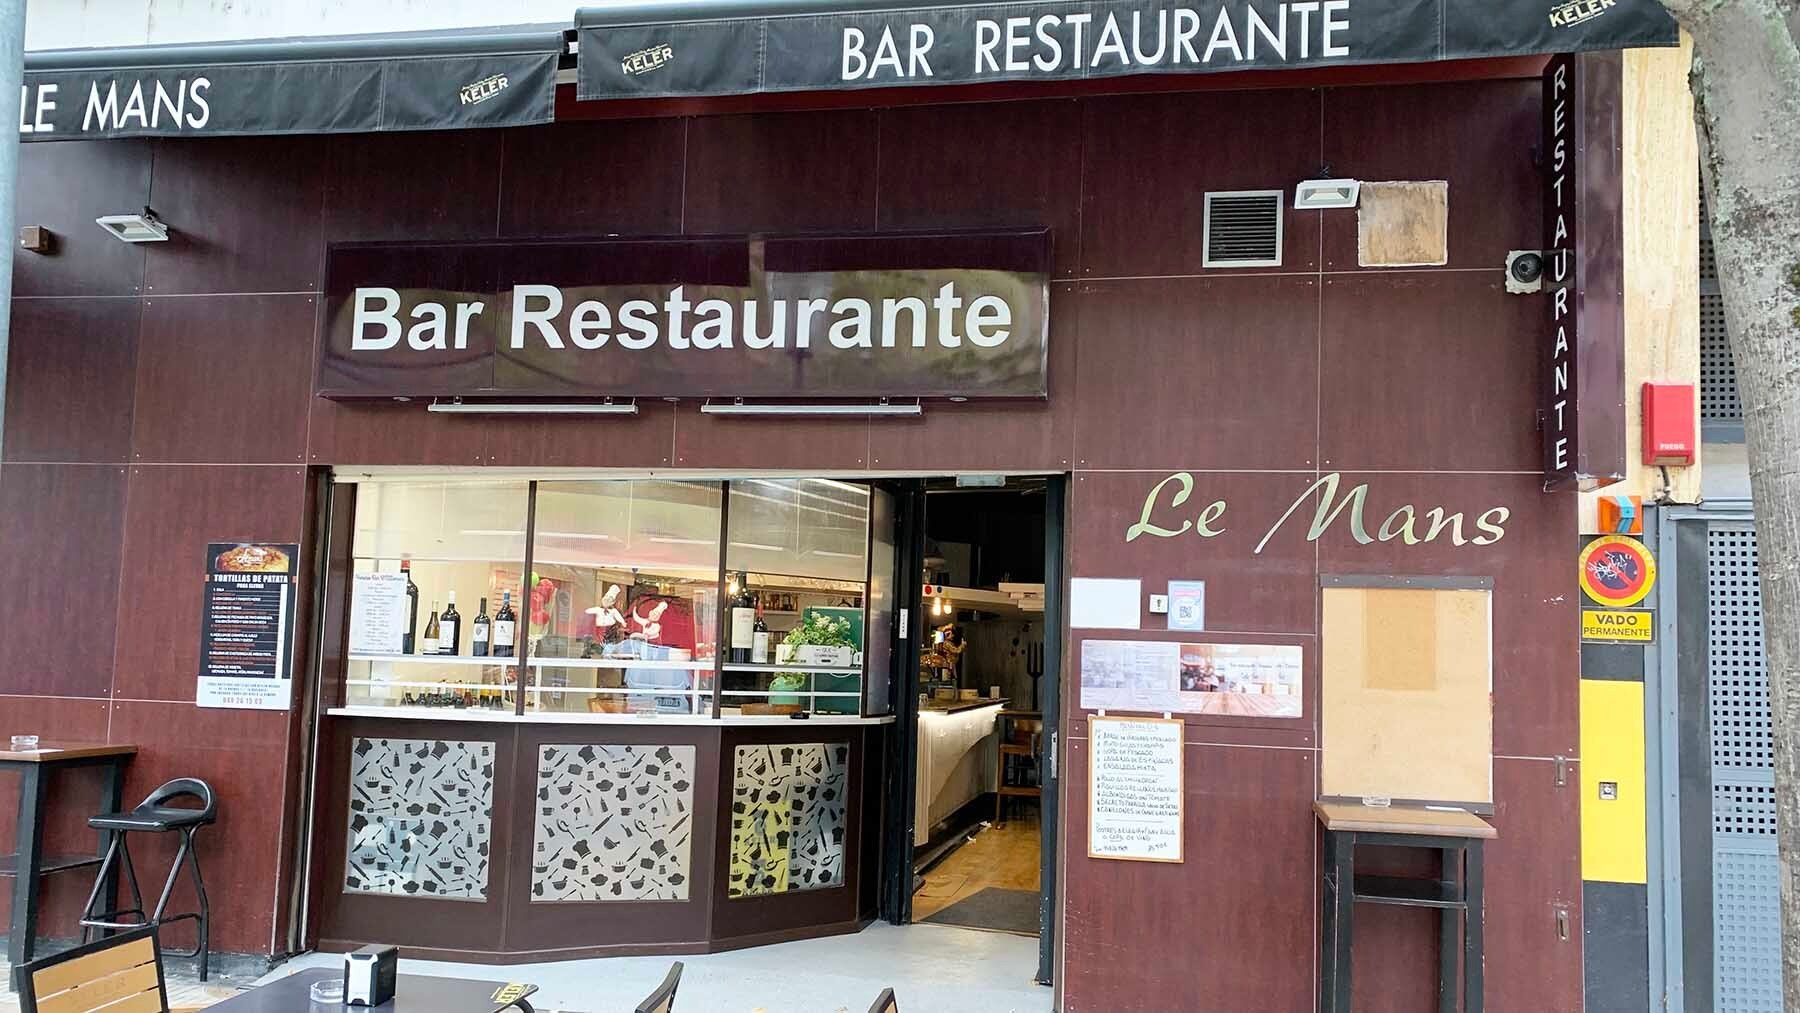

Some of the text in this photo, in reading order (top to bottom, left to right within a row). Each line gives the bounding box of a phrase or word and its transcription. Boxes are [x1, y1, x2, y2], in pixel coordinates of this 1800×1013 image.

[1549, 0, 1616, 27] KELER
[842, 0, 1349, 80] BAR RESTAURANTE
[622, 47, 674, 74] KELER
[19, 78, 210, 132] LE MANS
[460, 77, 509, 105] KELER
[1554, 64, 1568, 470] RESTAURANTE
[352, 282, 1011, 350] Bar Restaurante
[1126, 472, 1511, 554] Le Mans
[214, 574, 288, 584] TORTILLAS DE PATATA
[1584, 626, 1651, 637] PERMANENTE
[1596, 614, 1638, 625] VADO
